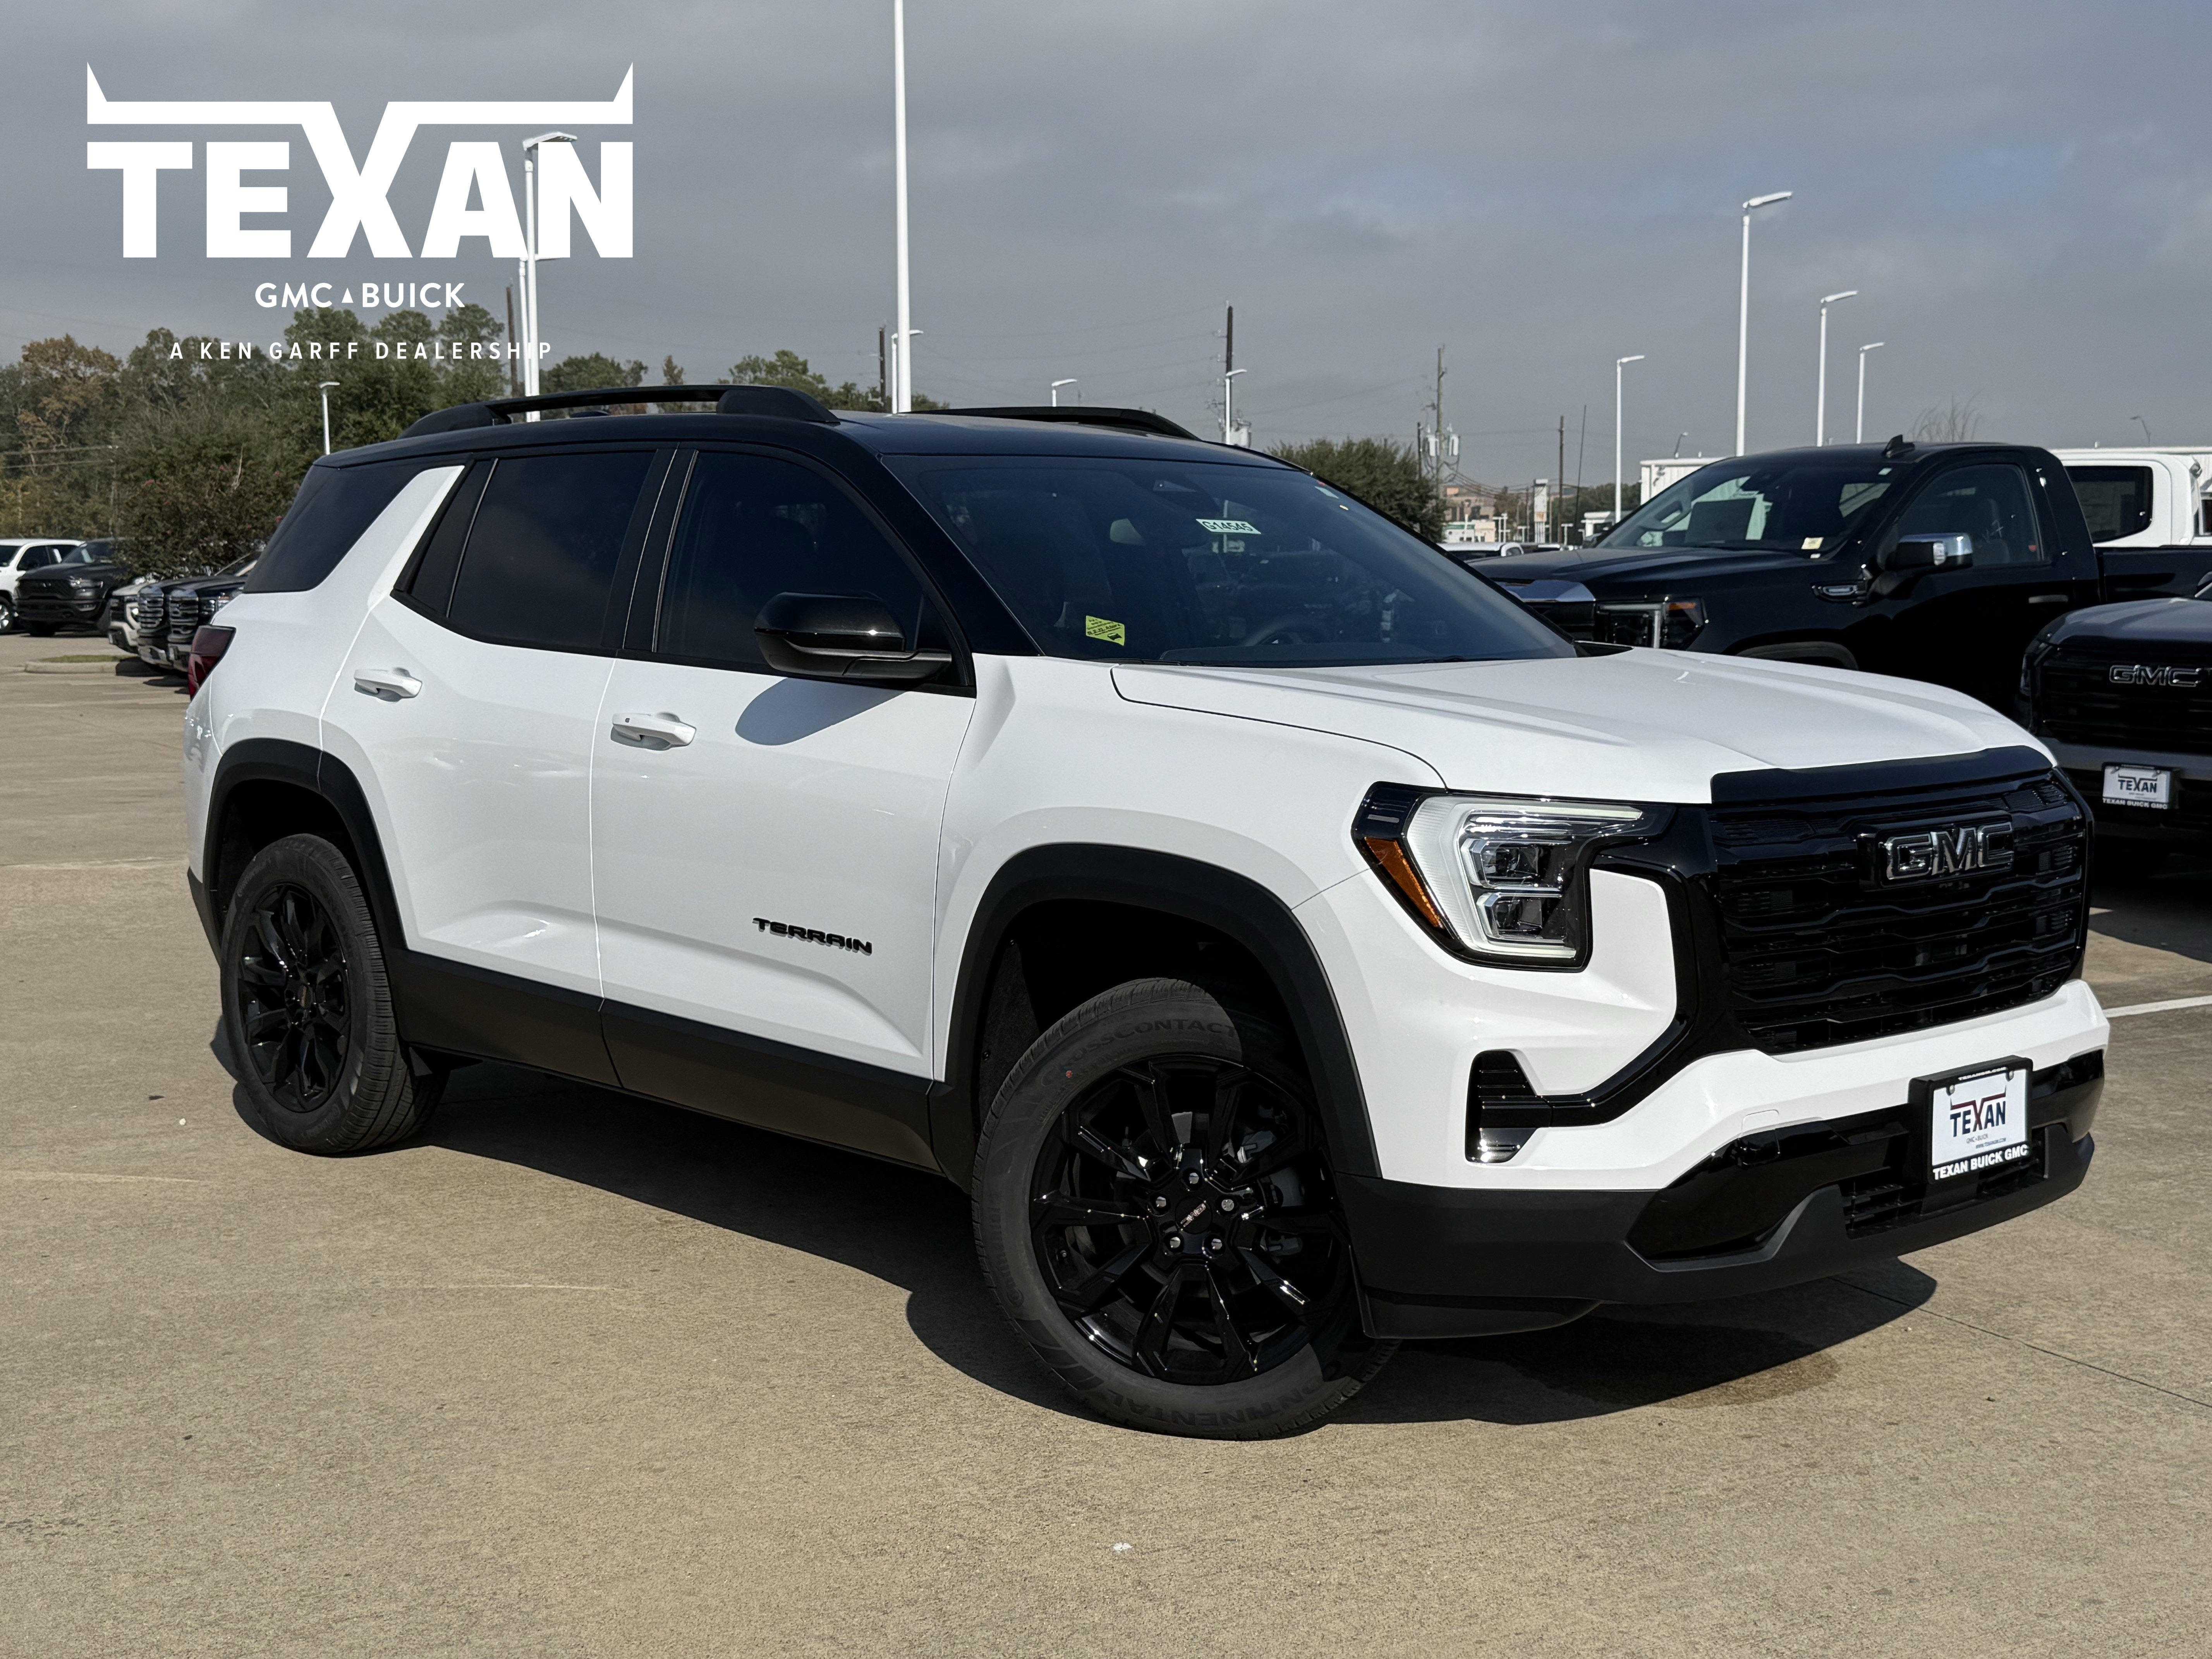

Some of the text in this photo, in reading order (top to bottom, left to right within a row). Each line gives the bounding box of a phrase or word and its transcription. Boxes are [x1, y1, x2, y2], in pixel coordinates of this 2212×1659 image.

[1202, 521, 1253, 531] G14545
[2109, 664, 2197, 687] GMC
[2118, 778, 2157, 793] TEXAN
[1886, 821, 2013, 880] GMC
[752, 917, 872, 956] TERRAIN
[1950, 1096, 2006, 1137] TEXAN
[1933, 1144, 2028, 1180] TEXAN BUICK GMC
